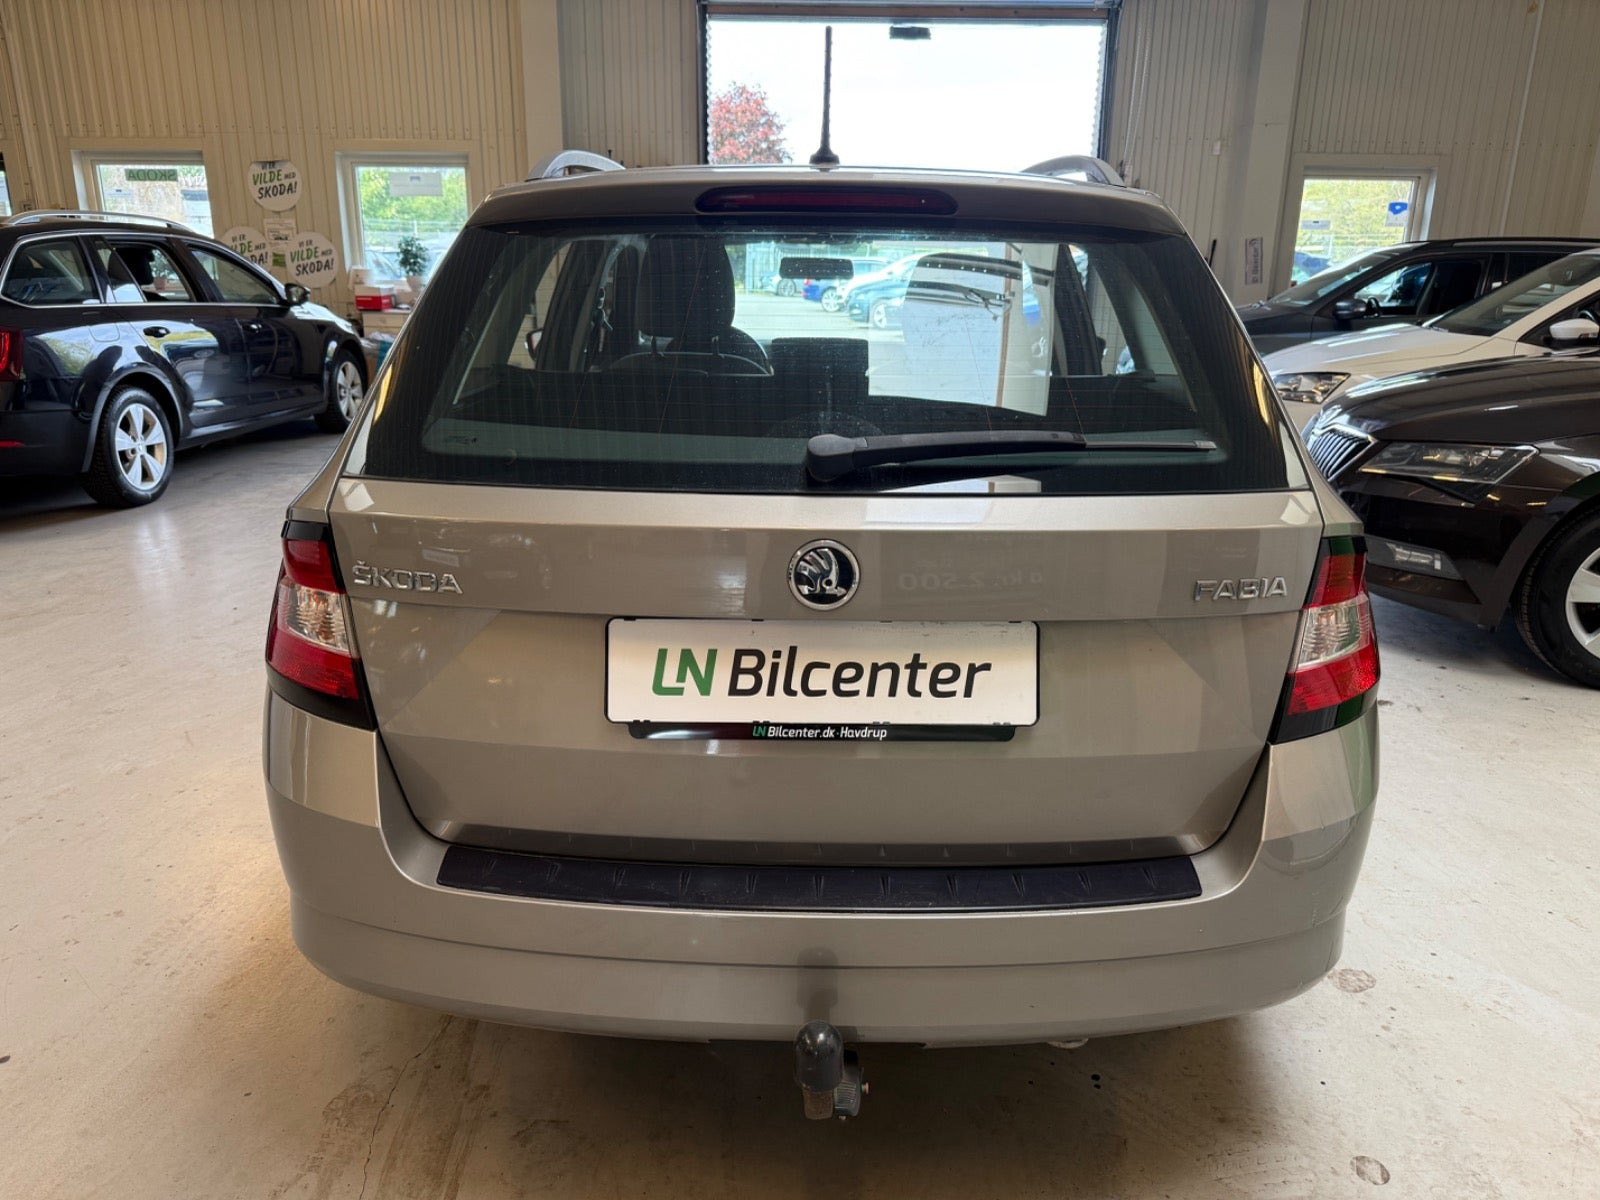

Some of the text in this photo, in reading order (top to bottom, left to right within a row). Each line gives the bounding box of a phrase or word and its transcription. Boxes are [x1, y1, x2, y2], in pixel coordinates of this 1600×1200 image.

[252, 169, 282, 186] VILDE
[258, 181, 297, 199] SKODA!
[250, 251, 268, 265] DA!
[290, 246, 319, 263] VILDE
[296, 258, 334, 276] SKODA!
[352, 560, 464, 594] ŠKODA
[1194, 577, 1287, 600] FABIA
[652, 645, 992, 698] LN Bilcenter
[752, 725, 767, 737] LN
[840, 726, 887, 741] Havdrup
